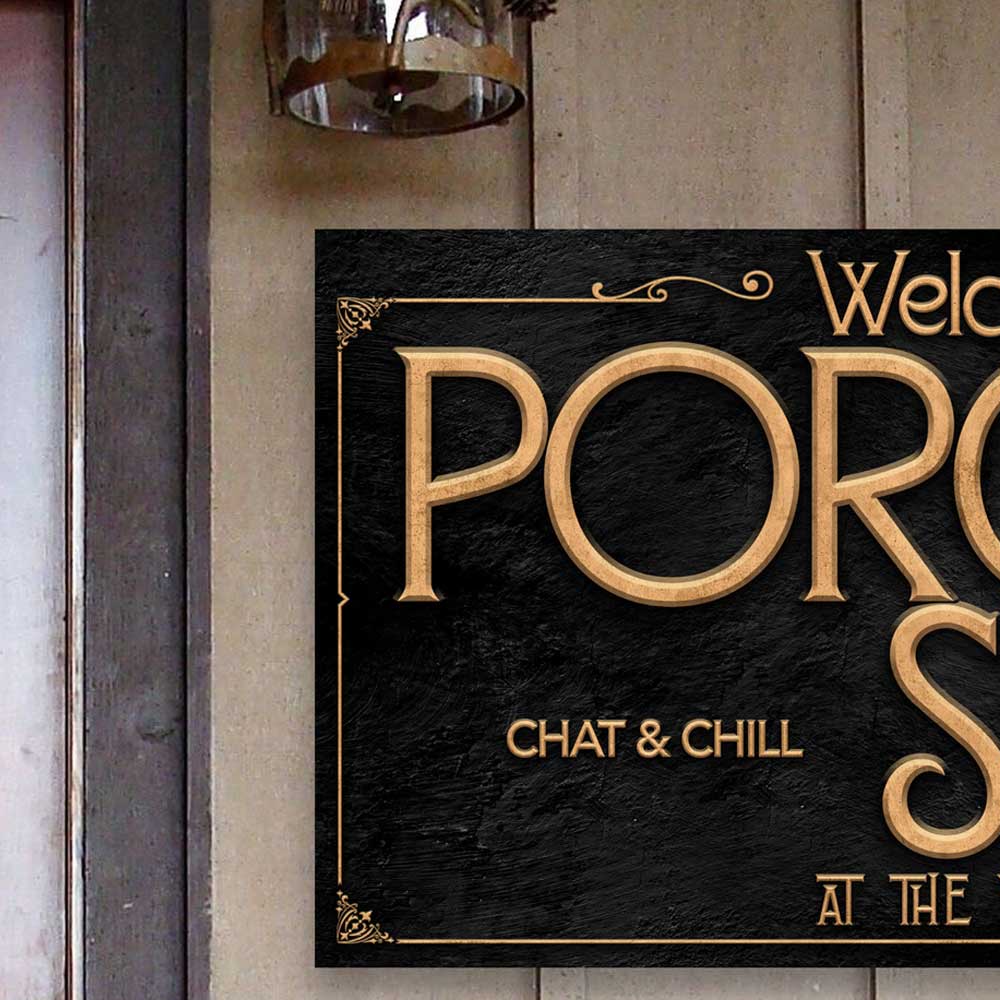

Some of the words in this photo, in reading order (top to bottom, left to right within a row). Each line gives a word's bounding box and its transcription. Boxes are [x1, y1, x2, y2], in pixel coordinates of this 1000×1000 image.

[506, 718, 627, 758] CHAT
[636, 718, 671, 758] &
[681, 718, 805, 758] CHILL
[815, 873, 865, 926] AT
[888, 873, 972, 926] THE
